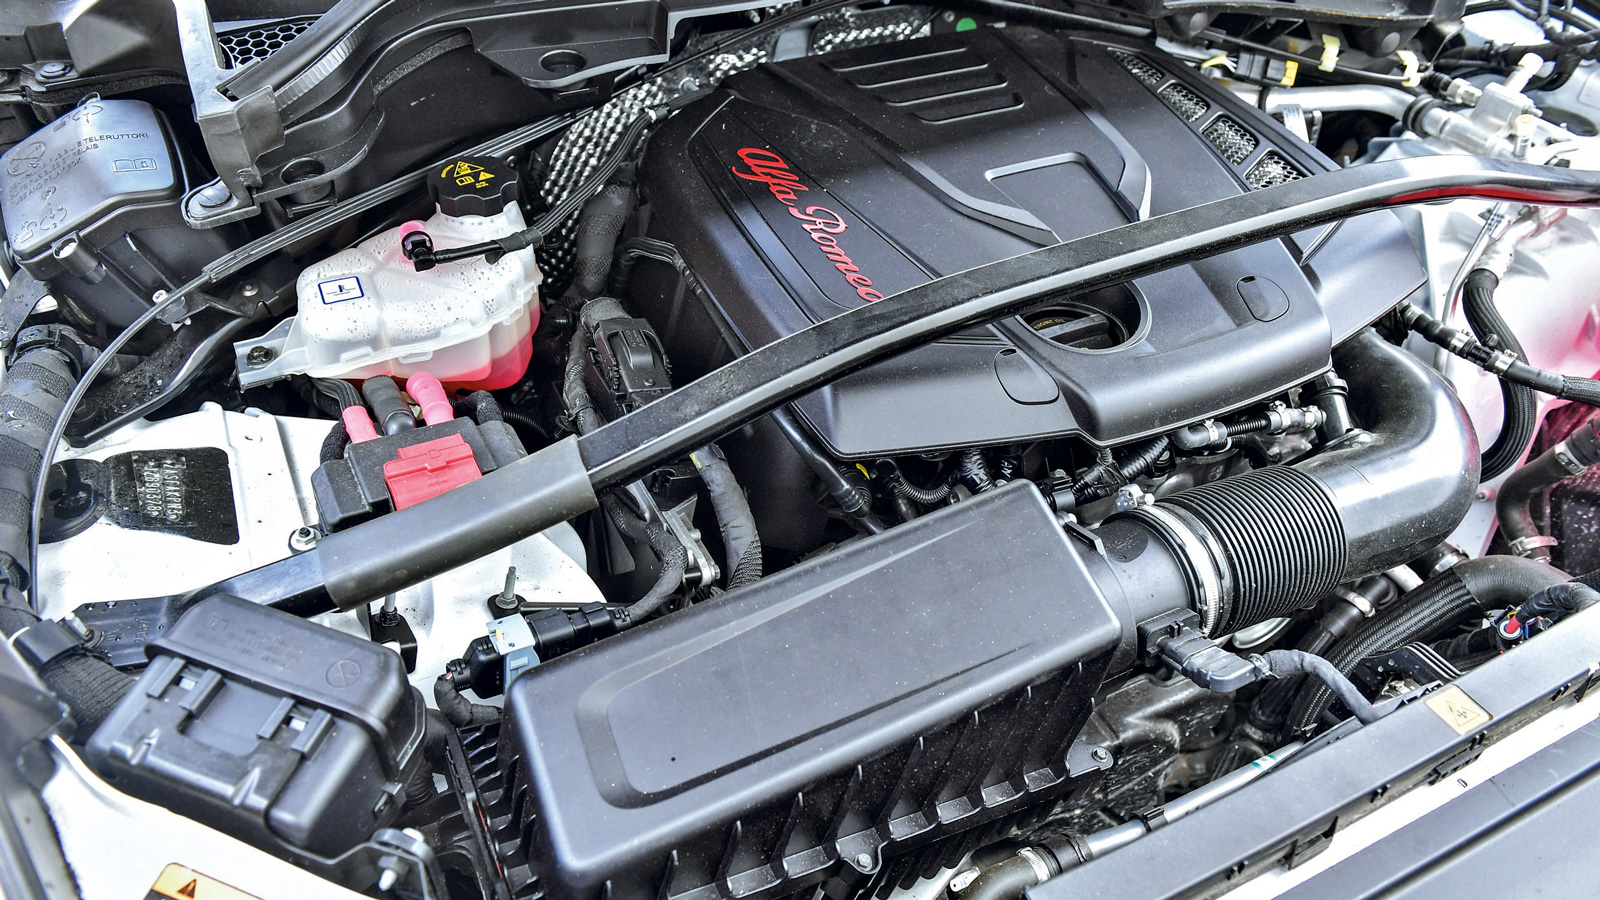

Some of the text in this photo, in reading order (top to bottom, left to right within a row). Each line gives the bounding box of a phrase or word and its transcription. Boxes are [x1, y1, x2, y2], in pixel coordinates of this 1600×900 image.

[83, 132, 149, 144] TELERUTTORI
[29, 162, 61, 186] FUSBLES
[72, 143, 99, 158] RELAIS
[731, 147, 885, 302] Alfa Romeo
[1033, 319, 1055, 330] ENGINE
